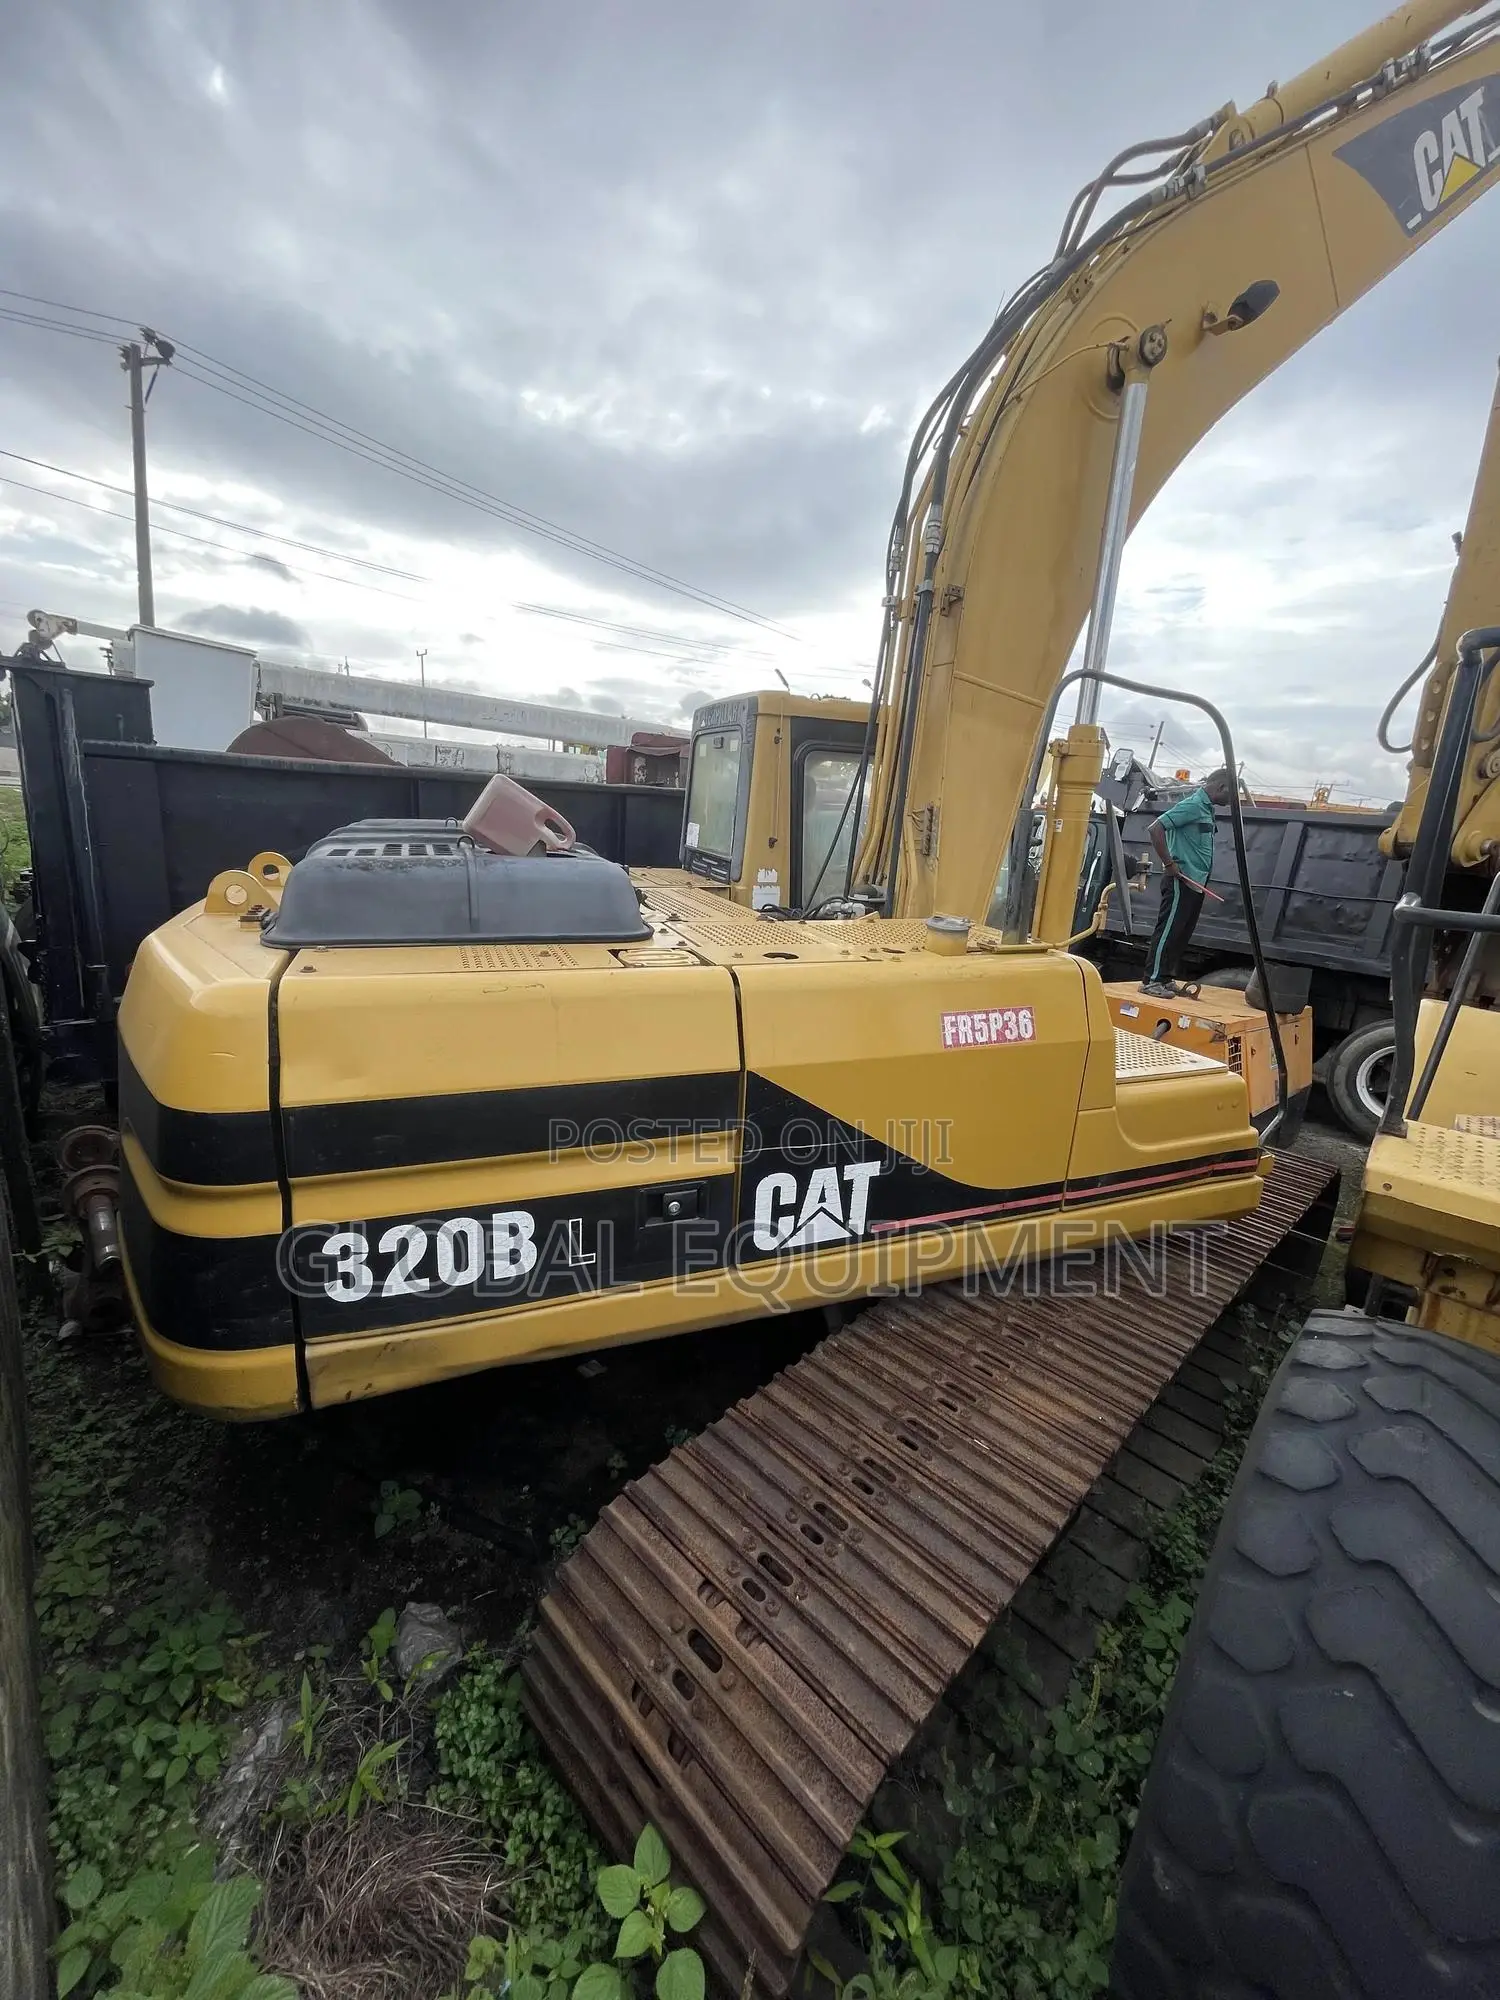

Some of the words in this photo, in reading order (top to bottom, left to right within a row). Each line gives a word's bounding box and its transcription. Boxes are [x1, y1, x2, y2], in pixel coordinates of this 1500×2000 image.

[1413, 86, 1485, 212] CAT
[943, 1009, 1034, 1046] FR5P36
[753, 1160, 881, 1251] CAT
[321, 1210, 538, 1303] 320B
[568, 1218, 596, 1267] L
